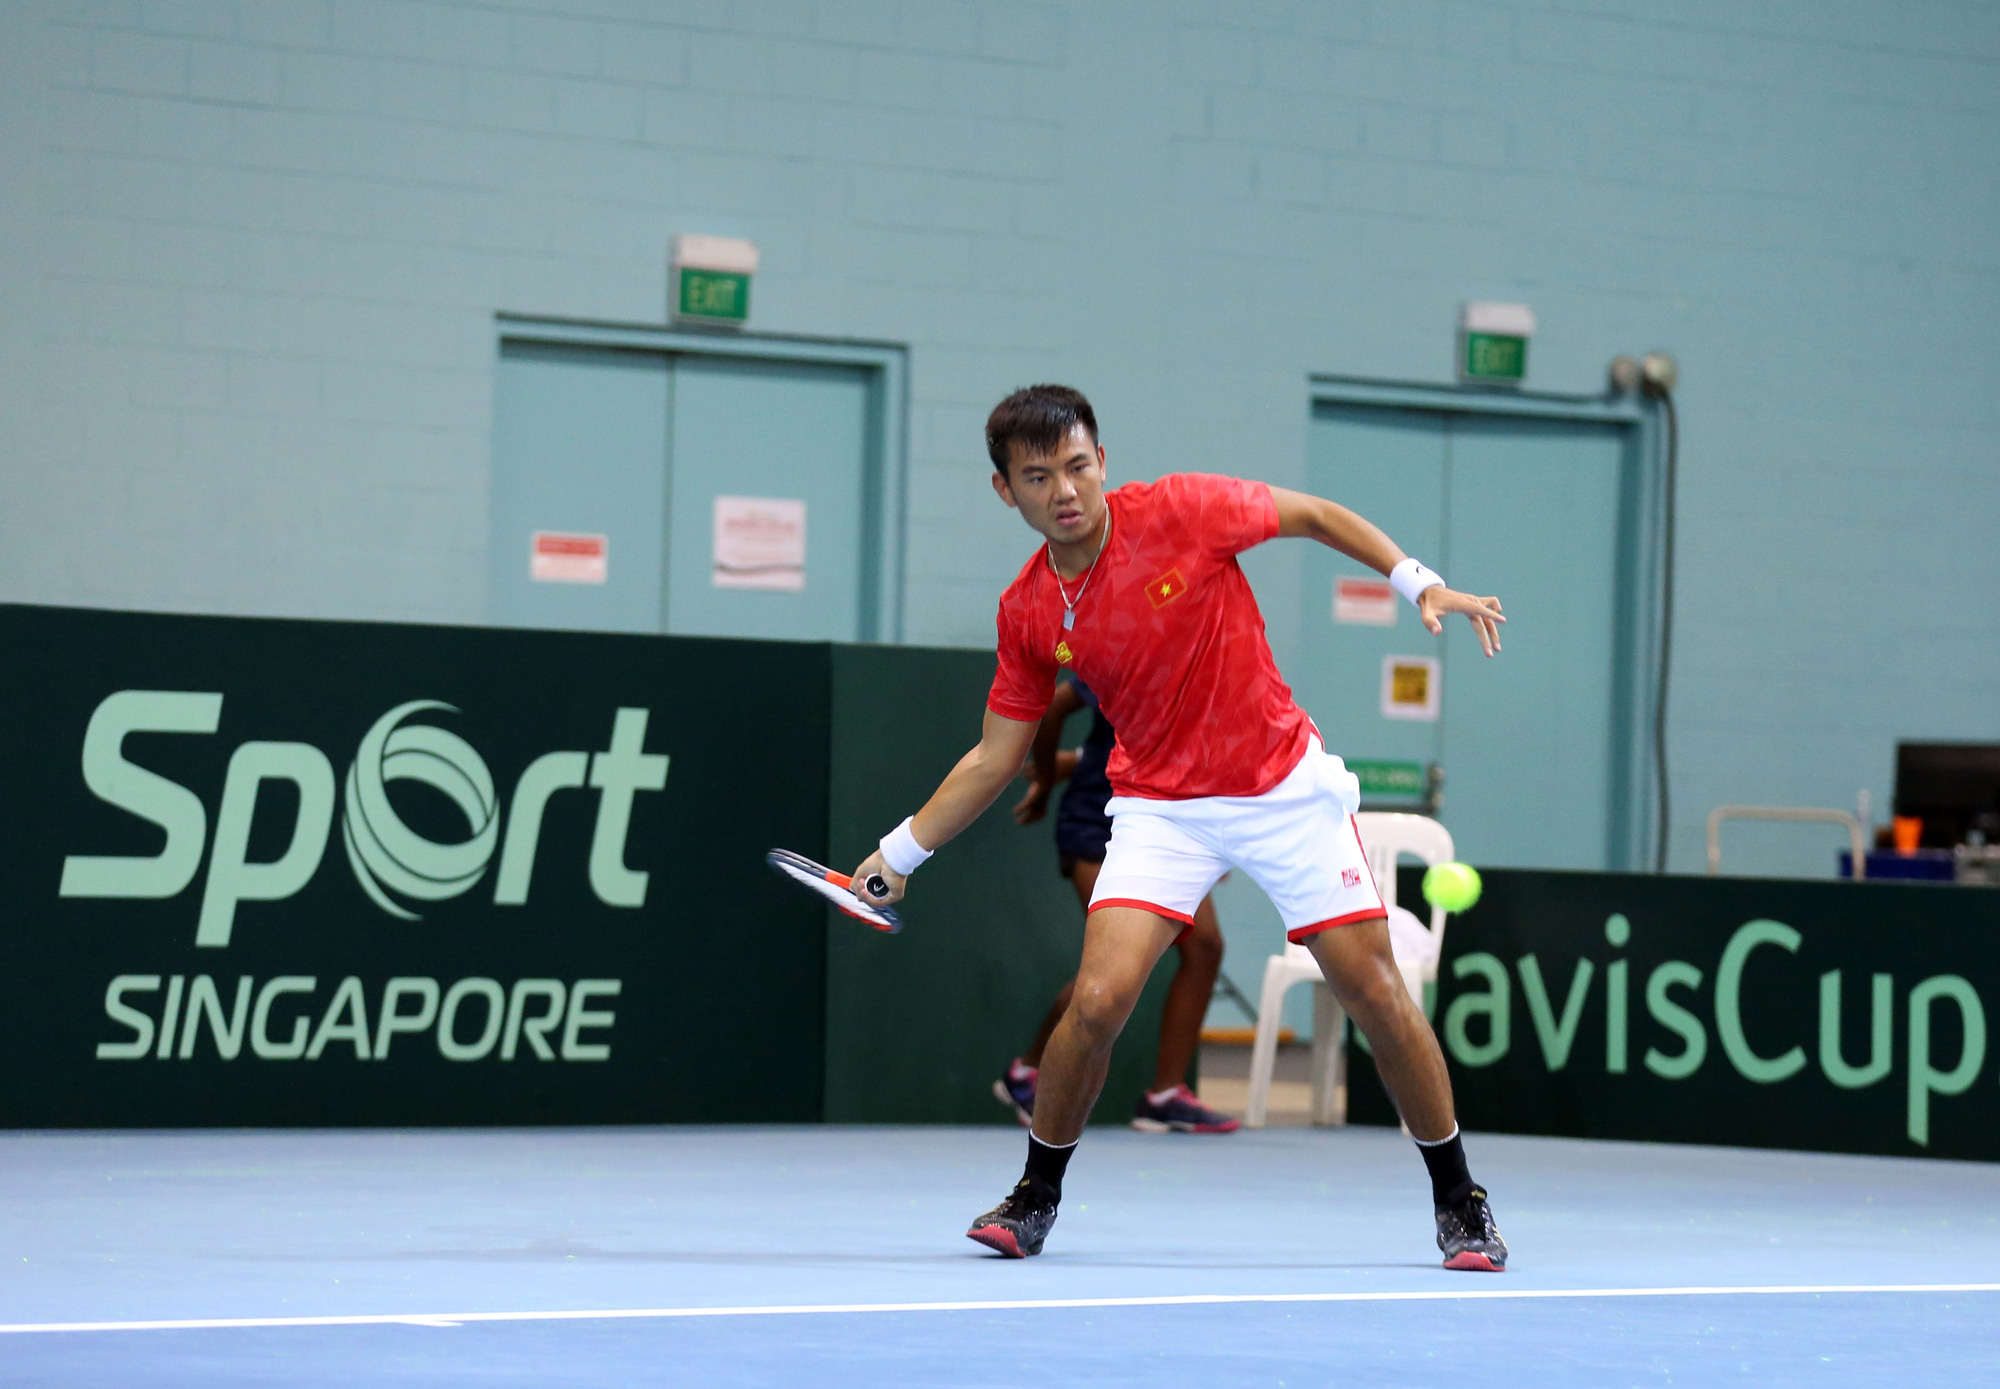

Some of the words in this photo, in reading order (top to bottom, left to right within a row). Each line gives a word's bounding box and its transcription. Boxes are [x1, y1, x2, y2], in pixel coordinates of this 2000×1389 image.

[59, 690, 669, 947] Sport
[96, 975, 622, 1061] SINGAPORE
[1353, 914, 1986, 1146] avisCup
